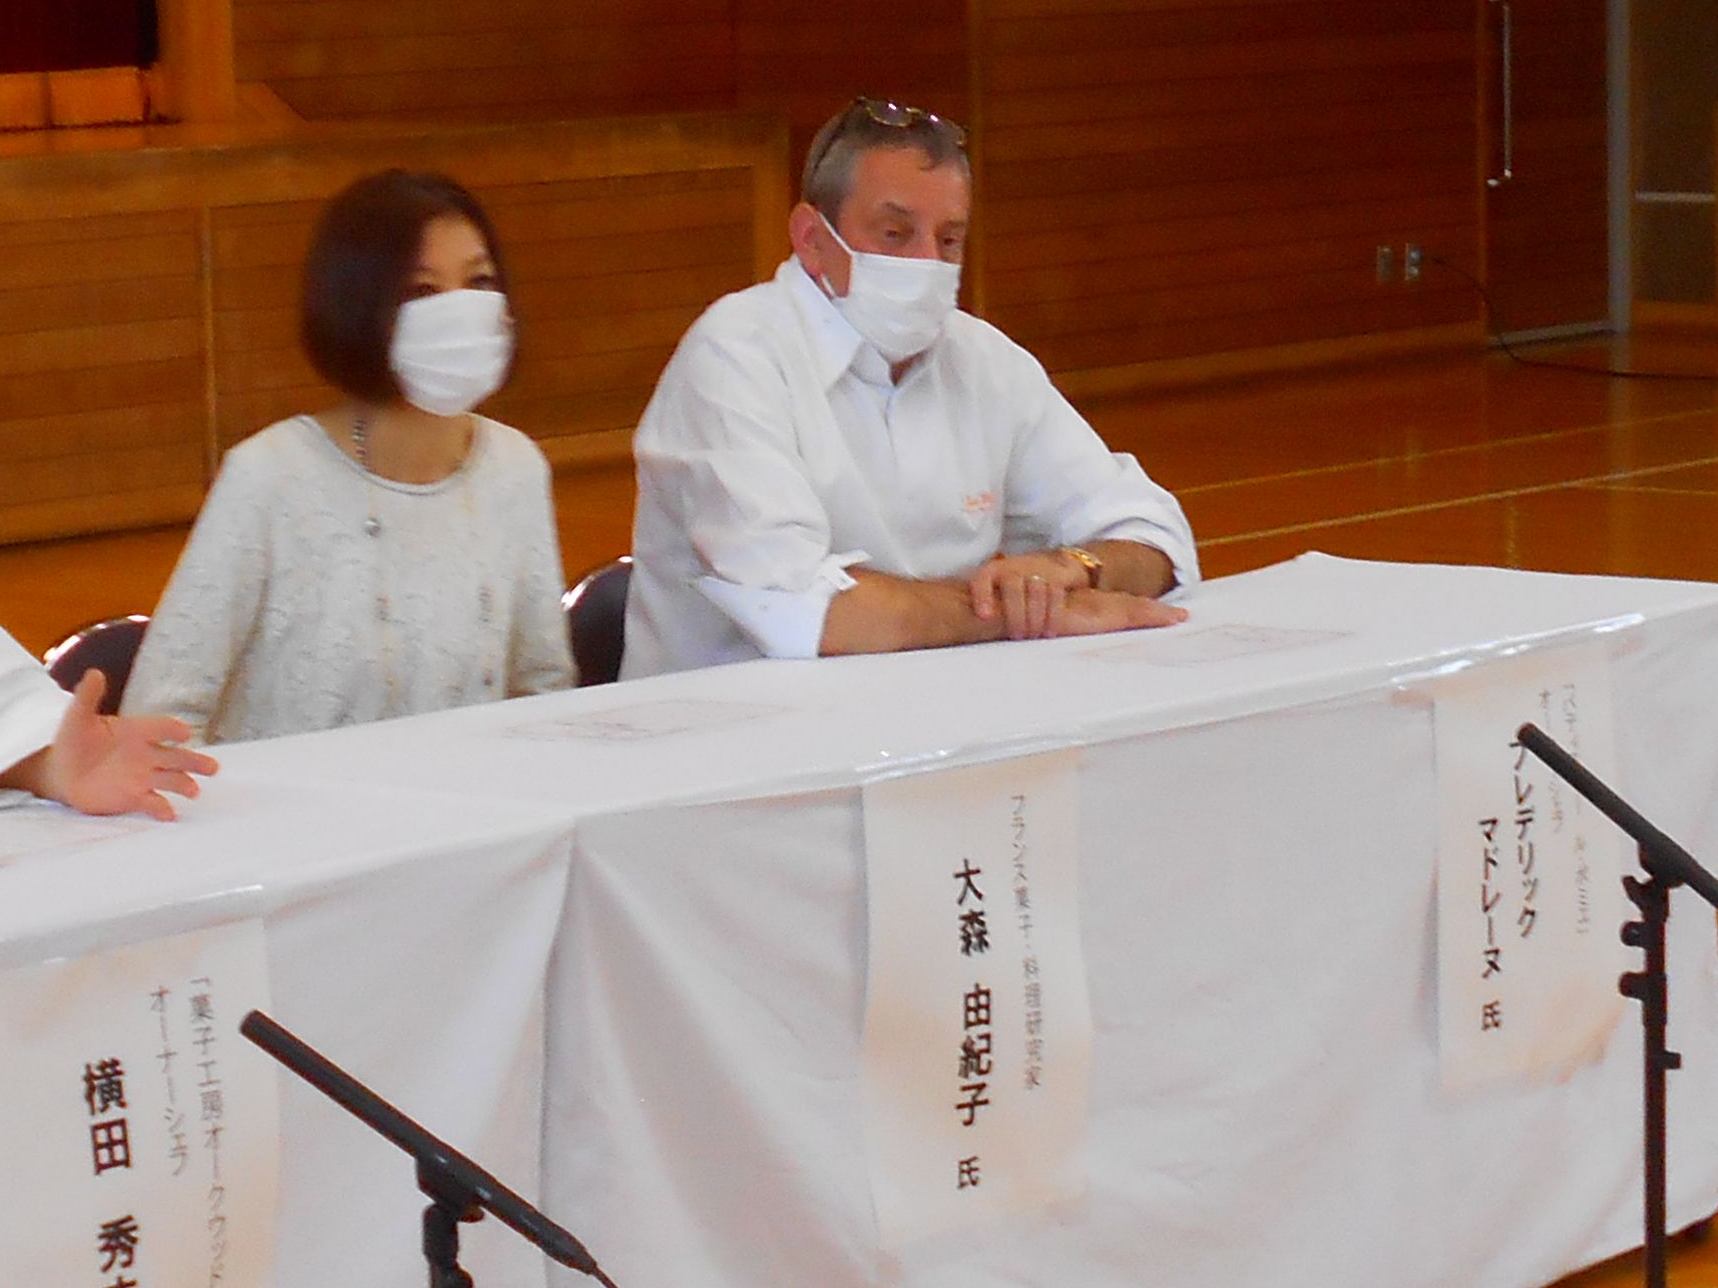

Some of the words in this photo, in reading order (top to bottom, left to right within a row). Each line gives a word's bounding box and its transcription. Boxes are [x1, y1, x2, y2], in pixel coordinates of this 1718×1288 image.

[952, 859, 990, 956] 大森
[1479, 817, 1501, 979] マドレーヌ
[954, 984, 992, 1127] 由紀子
[1481, 1000, 1502, 1031] 氏
[83, 1057, 133, 1176] 横田
[149, 985, 189, 1177] オーナーシェフ
[957, 1155, 980, 1190] 氏
